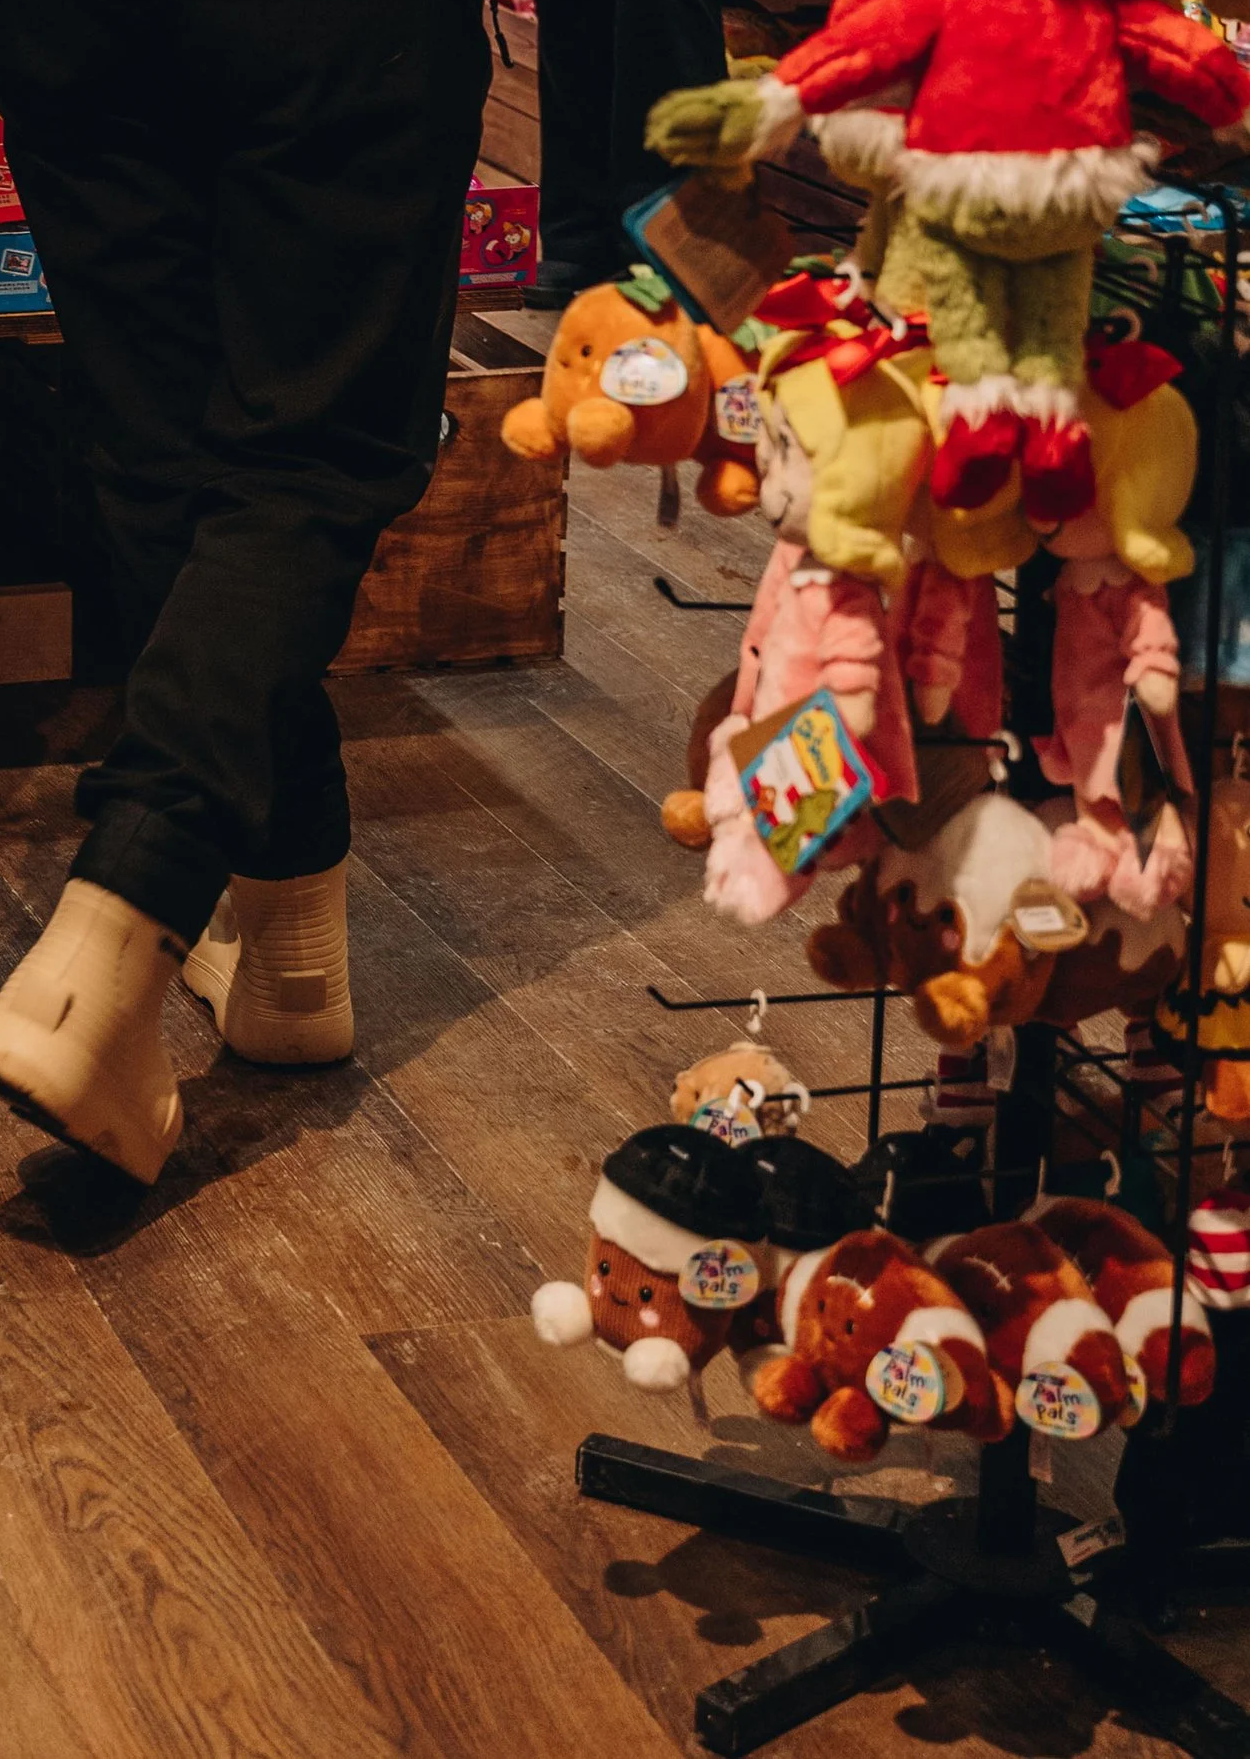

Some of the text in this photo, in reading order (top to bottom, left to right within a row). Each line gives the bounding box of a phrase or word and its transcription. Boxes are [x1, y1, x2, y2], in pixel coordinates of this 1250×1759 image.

[882, 1358, 926, 1388] Palm
[883, 1377, 919, 1408] Pals
[1032, 1381, 1081, 1406] Palm
[1035, 1402, 1078, 1425] Pals
